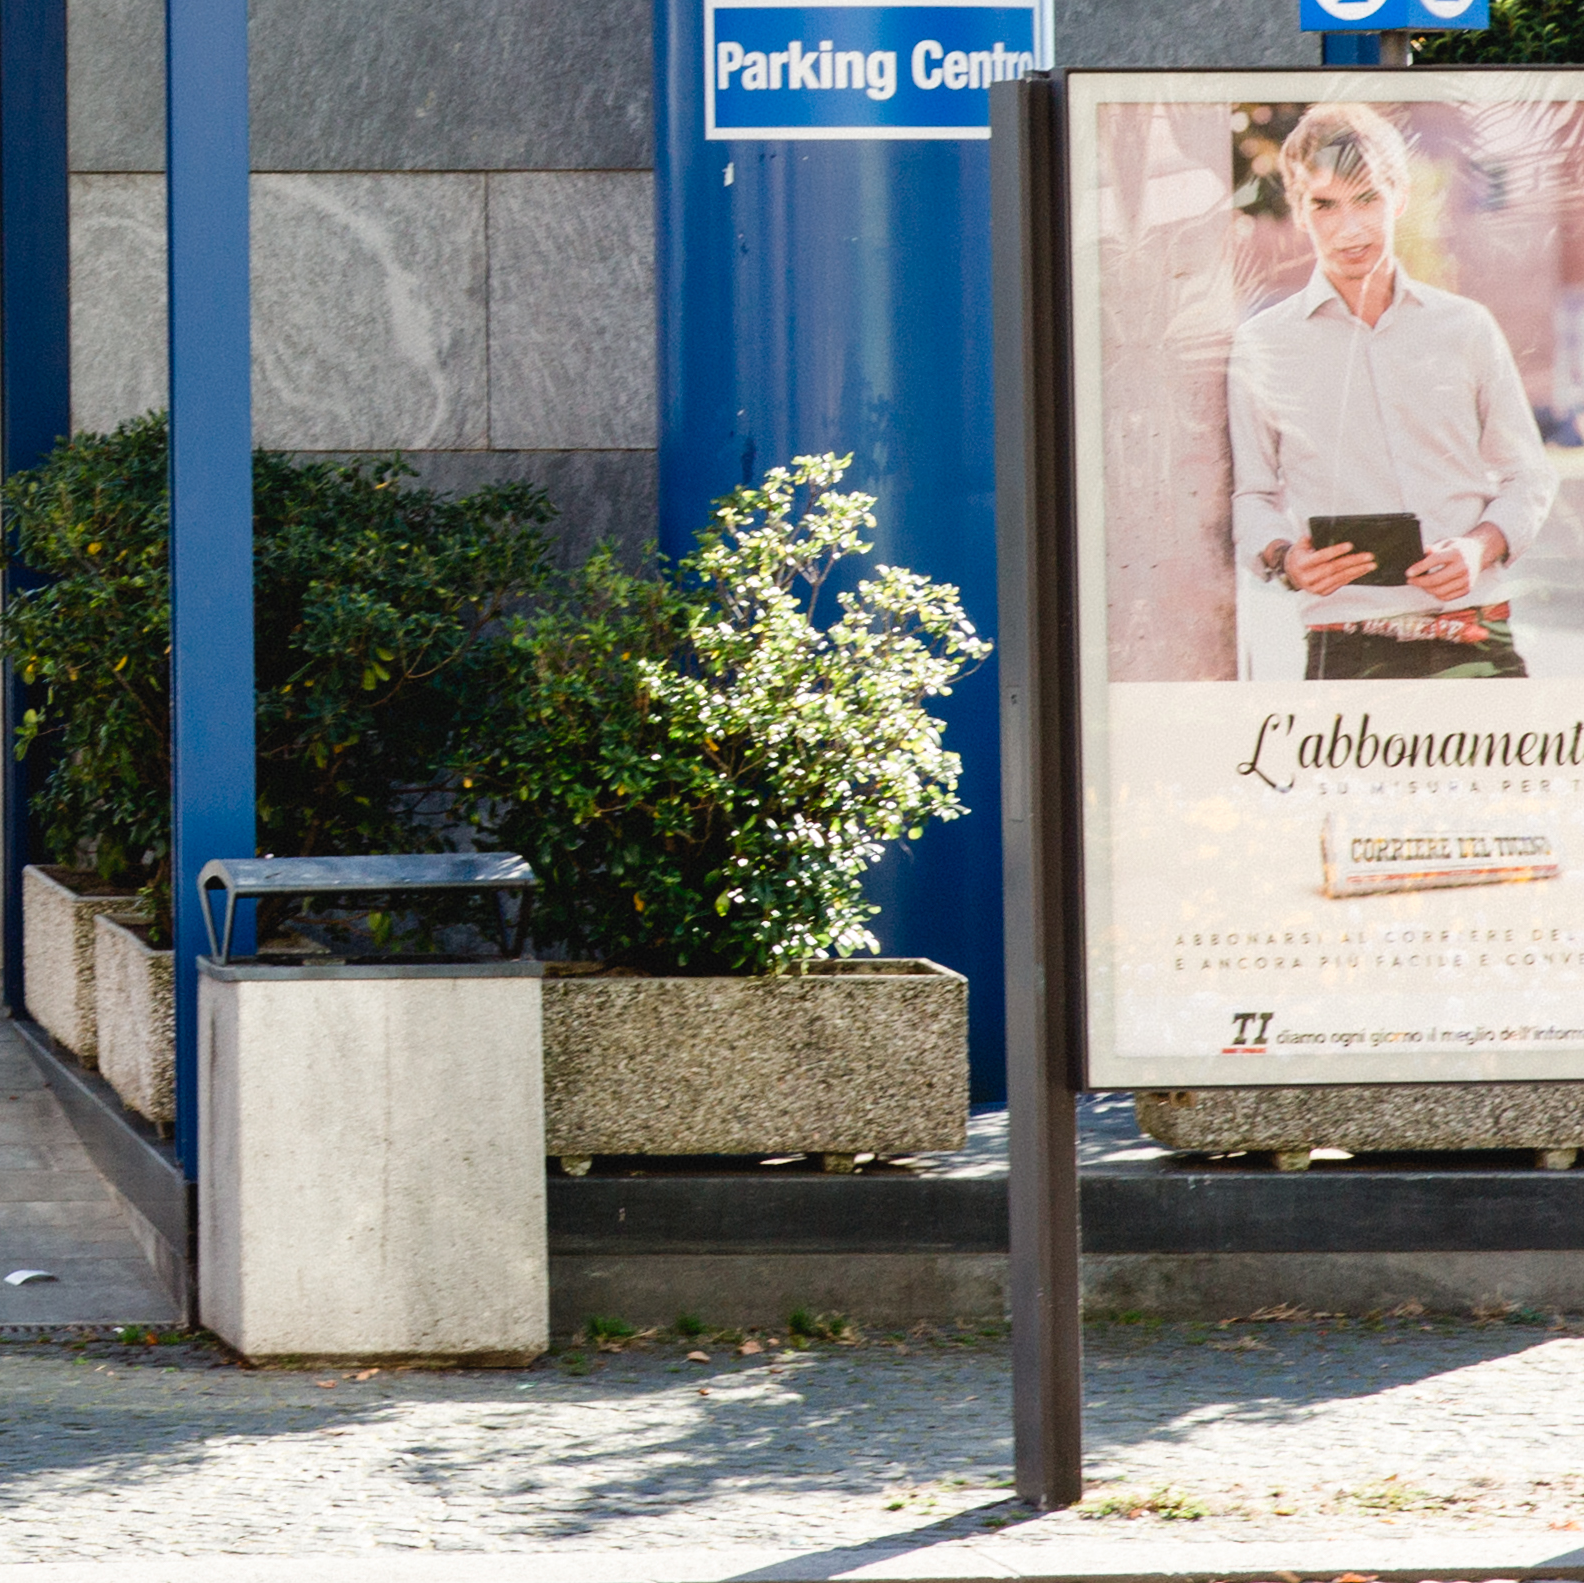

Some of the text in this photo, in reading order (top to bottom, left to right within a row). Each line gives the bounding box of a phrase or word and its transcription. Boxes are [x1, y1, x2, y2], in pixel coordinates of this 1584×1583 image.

[717, 39, 1033, 100] Parking Centro
[1236, 713, 1584, 794] L'abbonament
[1502, 780, 1552, 792] PER
[1350, 838, 1452, 863] CORRIERE
[1174, 932, 1323, 946] ABBONARSI
[1340, 931, 1365, 944] AL
[1385, 929, 1513, 943] CORRERE
[1201, 957, 1303, 970] ANCORA
[1375, 954, 1463, 968] FACILE
[1479, 953, 1489, 967] E
[1232, 1012, 1275, 1046] TI
[1276, 1028, 1327, 1045] diamo
[1330, 1028, 1366, 1048] ogni
[1370, 1027, 1424, 1047] giorno
[1440, 1025, 1496, 1046] meglio
